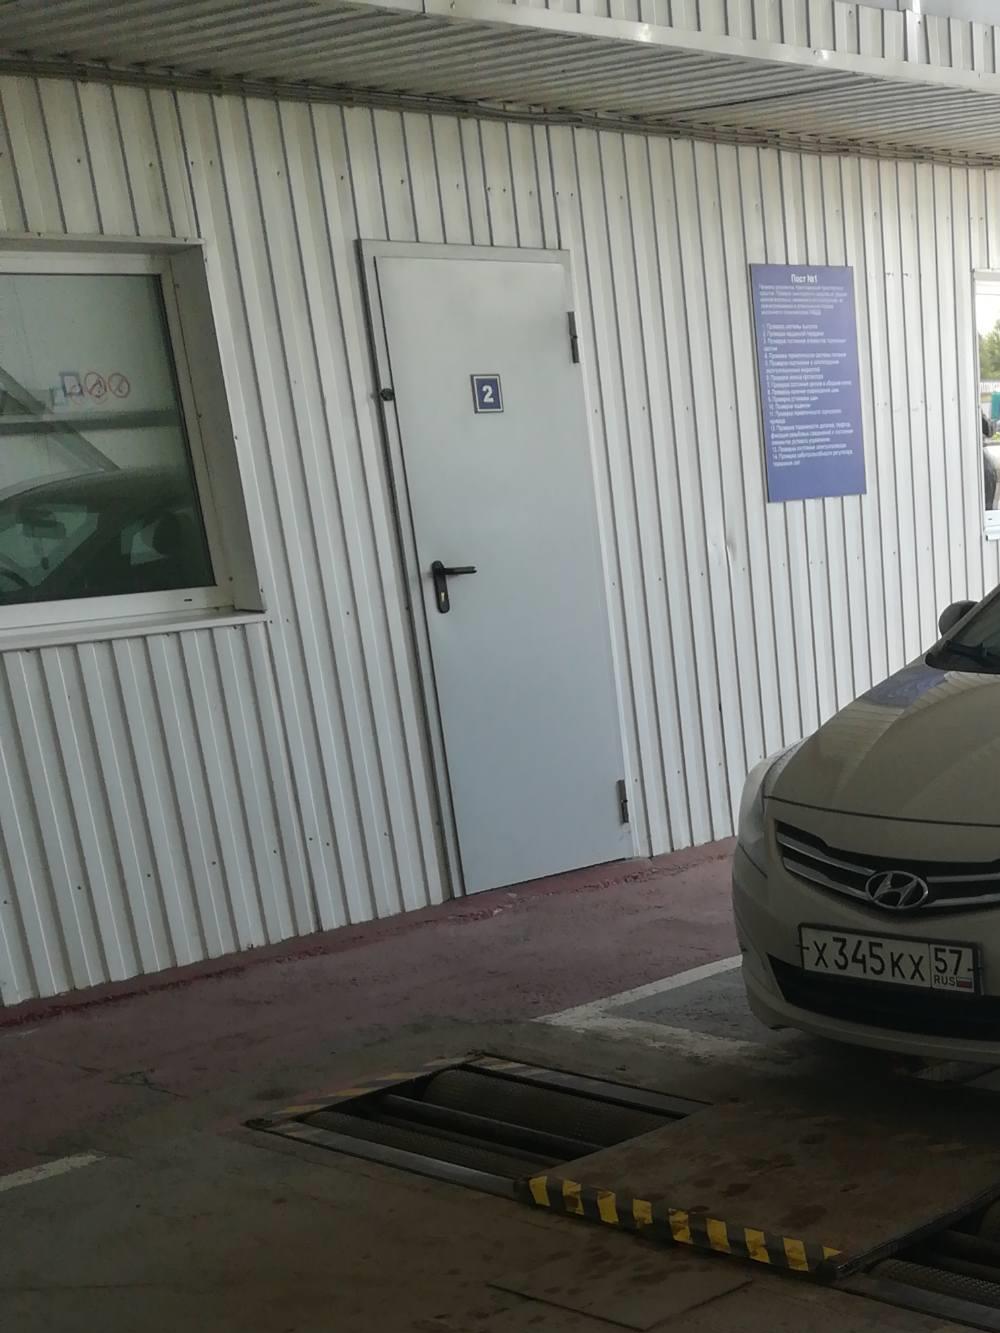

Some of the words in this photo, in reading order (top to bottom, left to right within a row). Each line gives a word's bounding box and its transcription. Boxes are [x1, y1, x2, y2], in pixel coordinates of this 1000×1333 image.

[482, 384, 494, 403] 2
[813, 936, 926, 982] Х345КХ
[934, 948, 963, 976] 57
[934, 974, 956, 987] RUS
